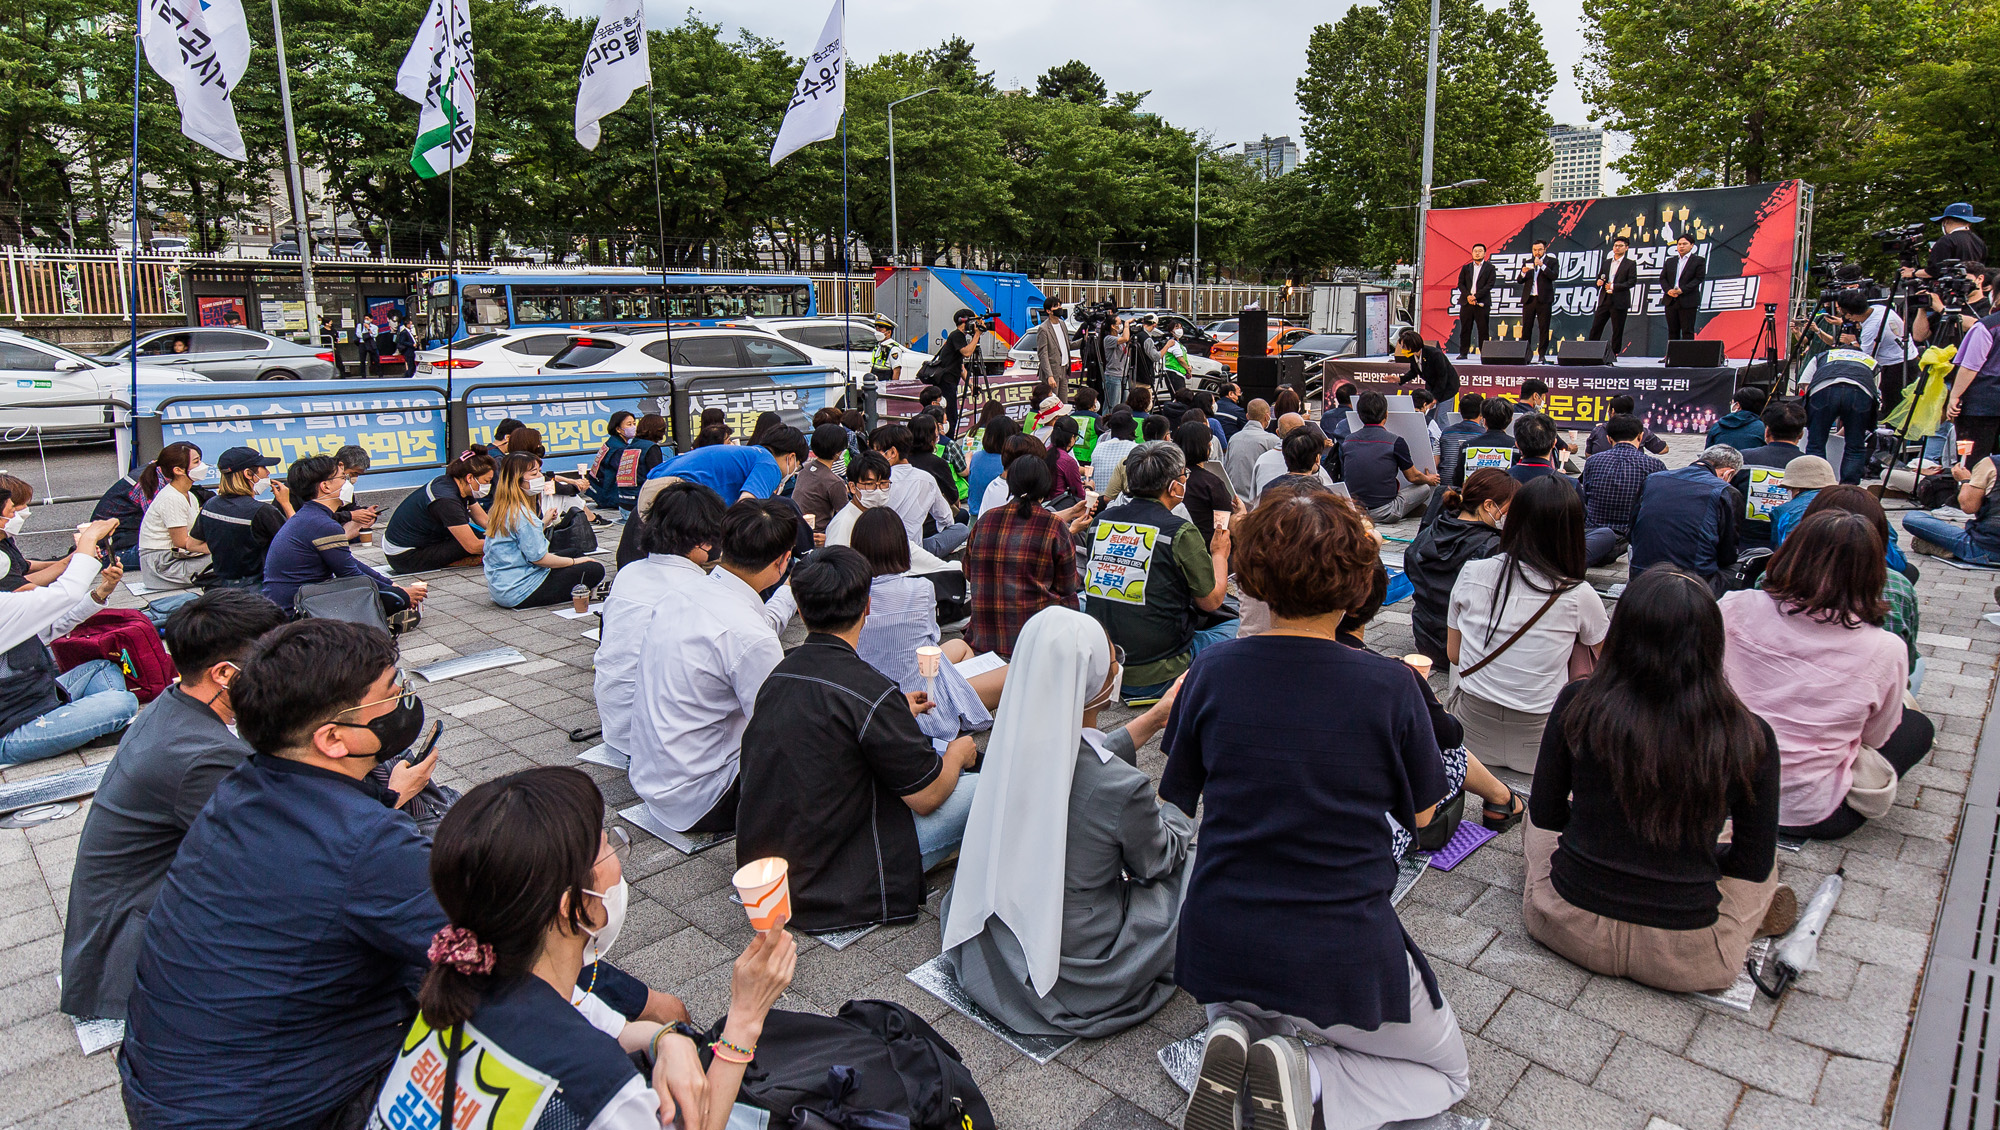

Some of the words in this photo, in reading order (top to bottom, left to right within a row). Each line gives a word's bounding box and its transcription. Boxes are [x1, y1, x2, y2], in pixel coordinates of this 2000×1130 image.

[1472, 374, 1493, 387] 전면
[1557, 377, 1580, 389] 정부
[1583, 378, 1630, 390] 국민안전
[1633, 378, 1657, 391] 역행
[1660, 379, 1690, 391] 규탄!
[1105, 543, 1138, 558] 공공성
[1097, 562, 1127, 576] 구석구석
[1093, 571, 1125, 588] 노동권
